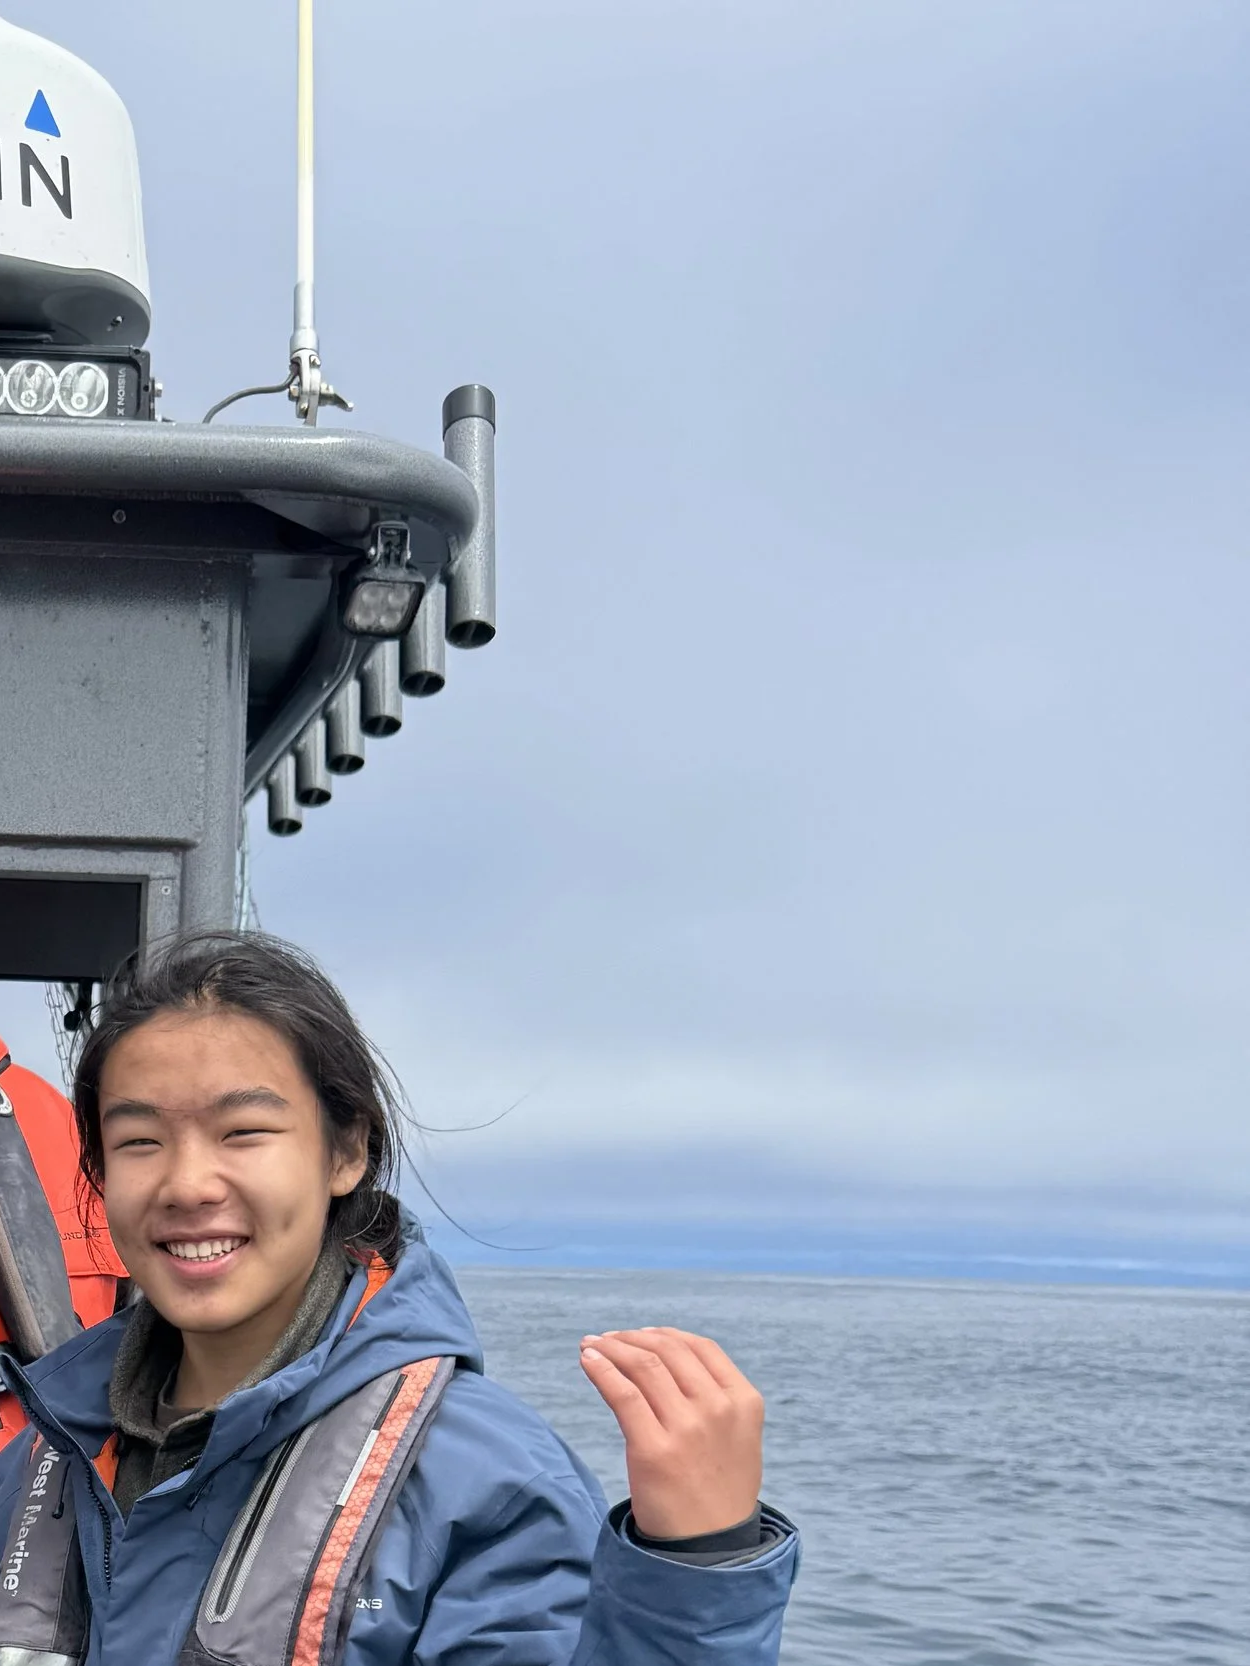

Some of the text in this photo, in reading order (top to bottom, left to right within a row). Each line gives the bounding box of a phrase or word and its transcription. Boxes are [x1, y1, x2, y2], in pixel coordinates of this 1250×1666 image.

[117, 367, 126, 416] VISION X
[3, 1504, 42, 1591] Marine
